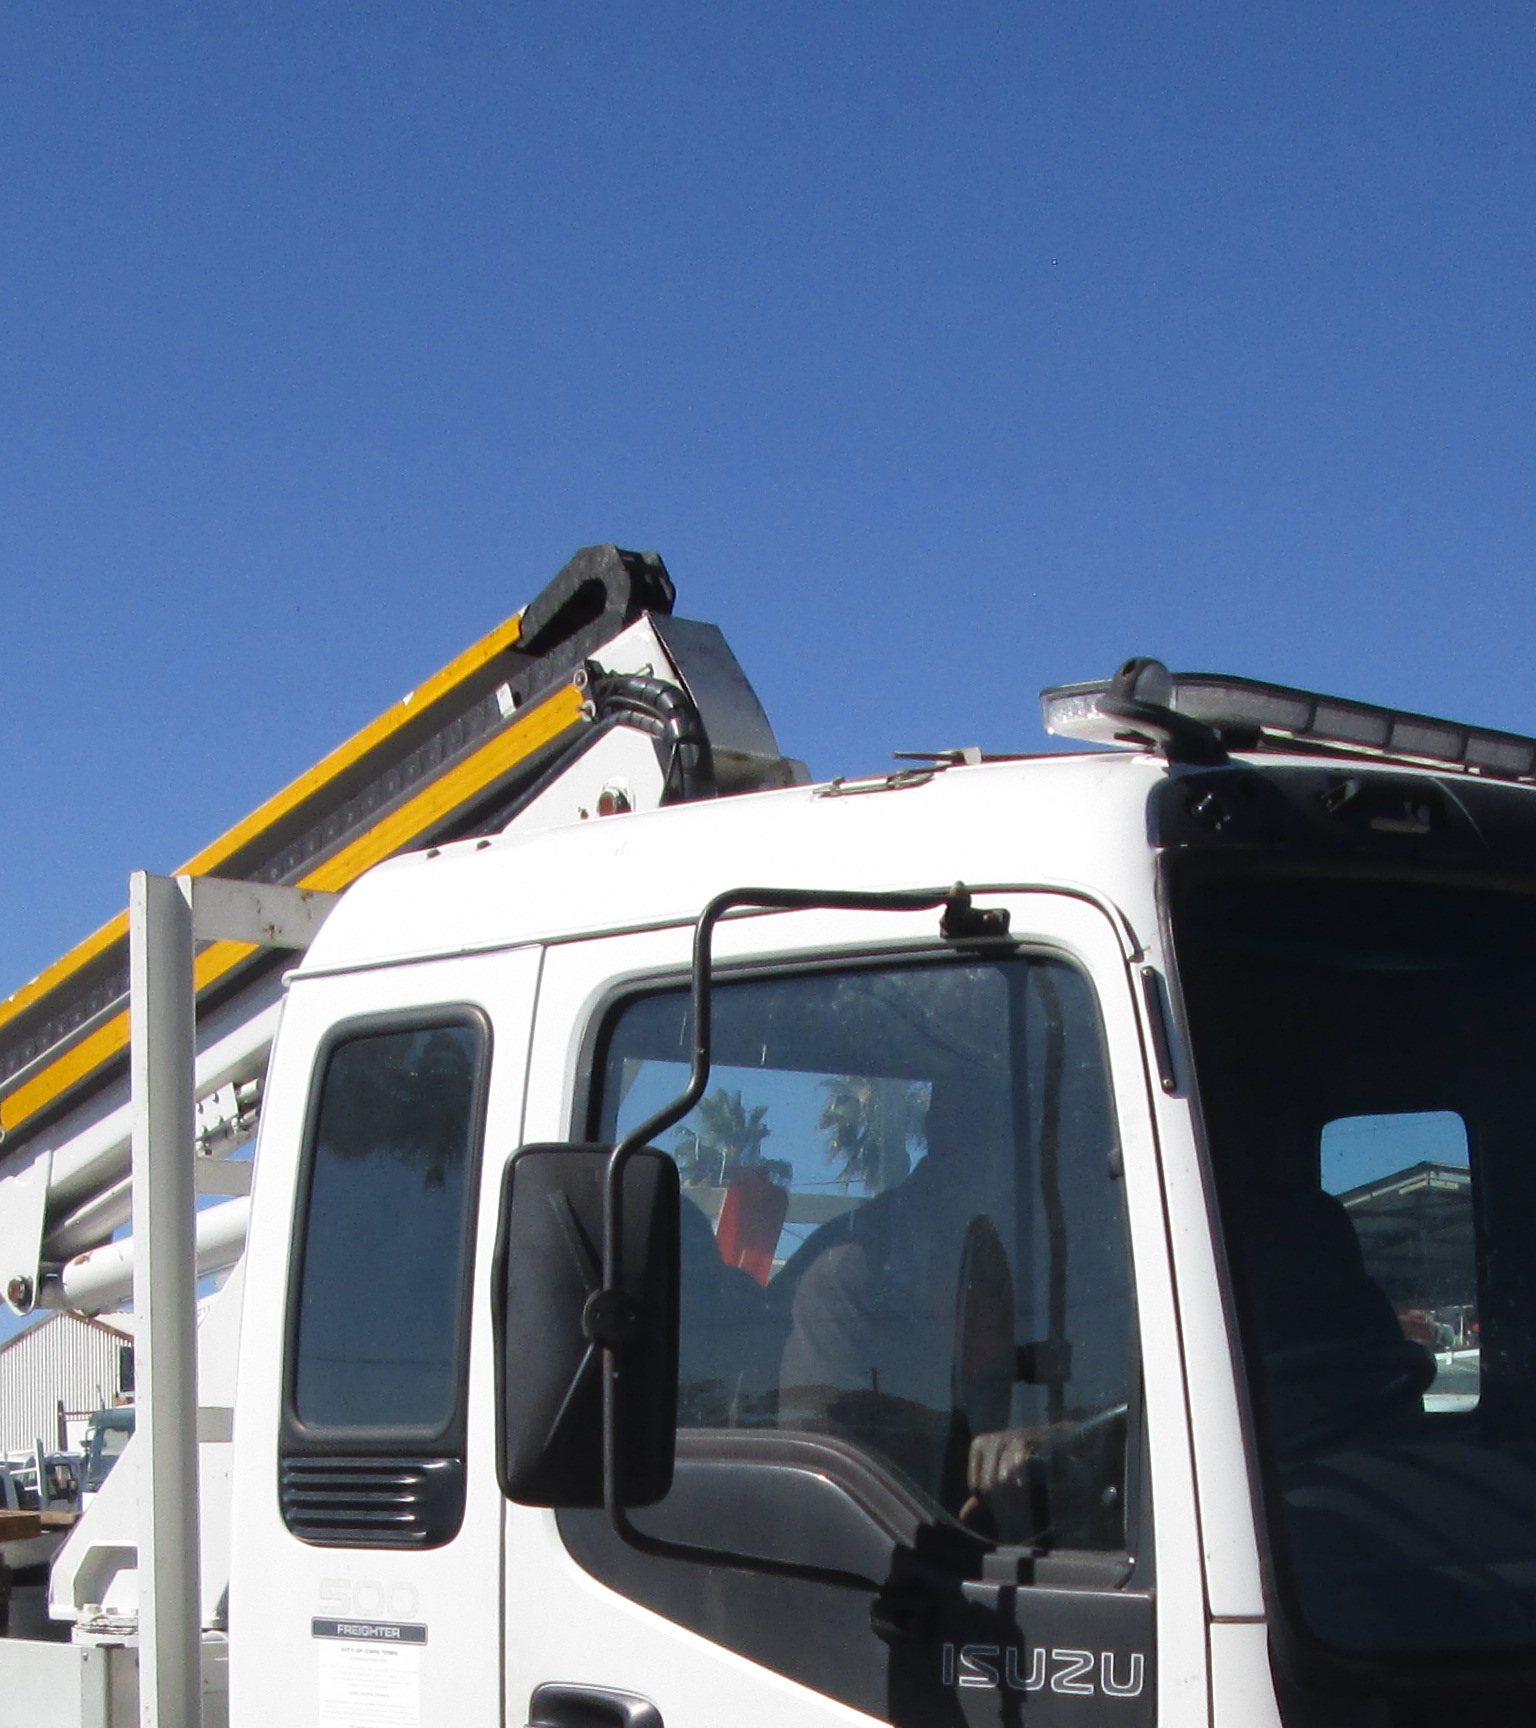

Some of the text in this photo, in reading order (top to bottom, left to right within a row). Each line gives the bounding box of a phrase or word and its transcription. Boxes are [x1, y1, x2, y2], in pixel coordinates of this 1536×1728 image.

[320, 1578, 420, 1620] 500
[336, 1623, 401, 1639] FREIGHTER
[942, 1643, 1145, 1697] ISUZU
